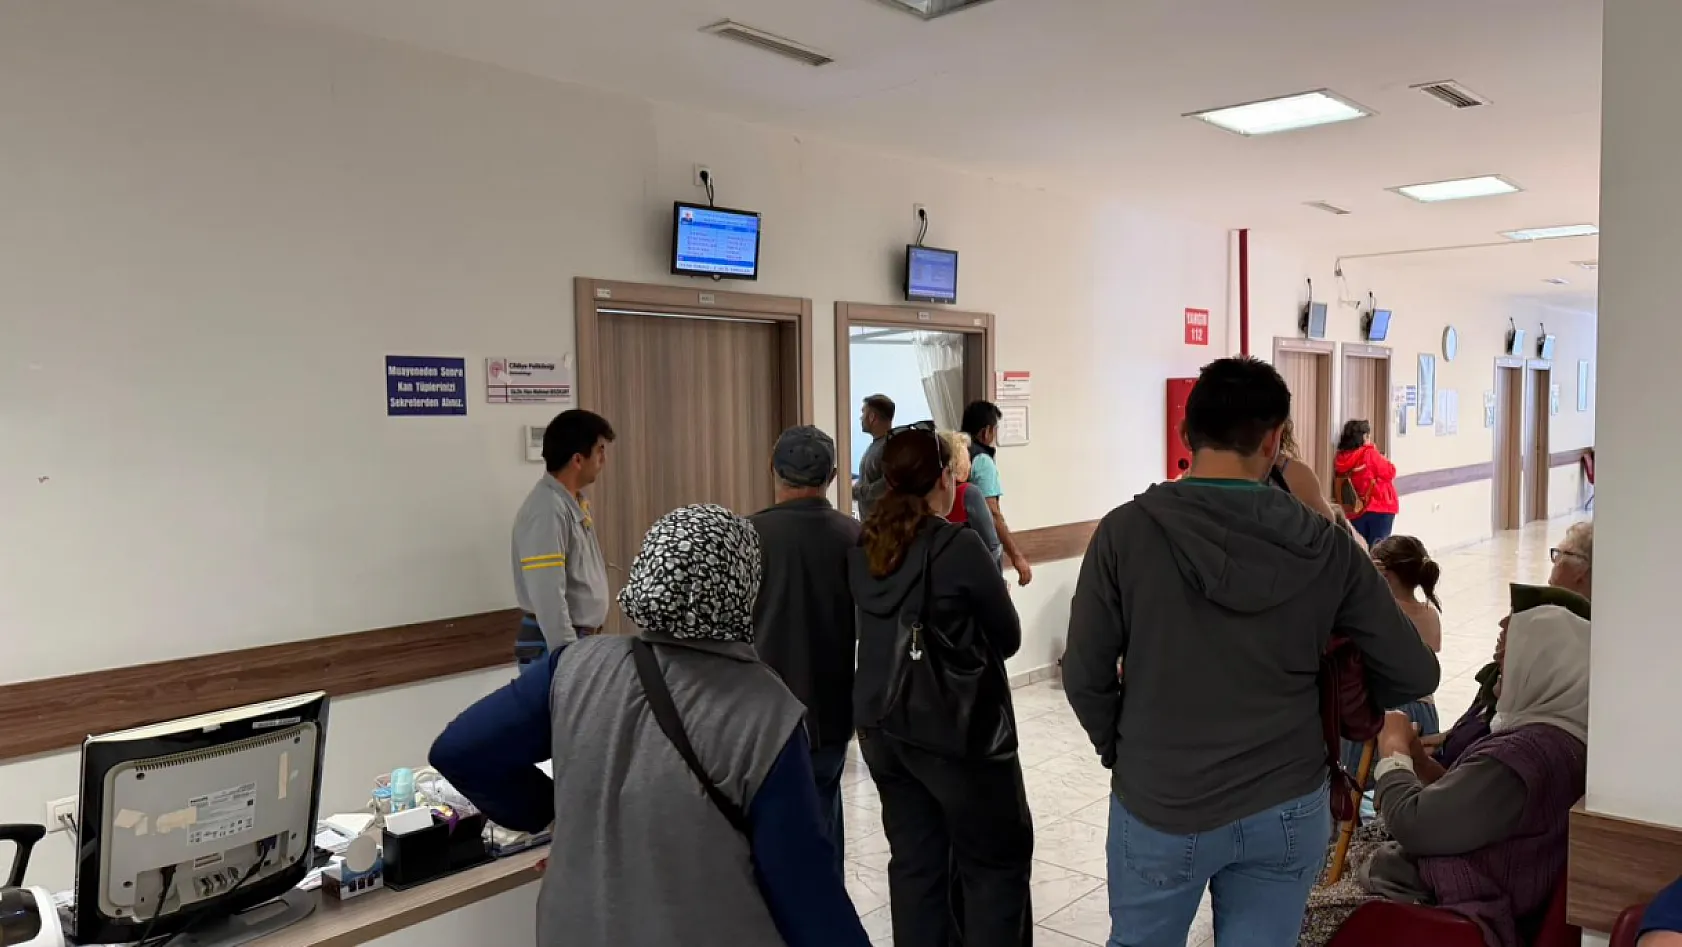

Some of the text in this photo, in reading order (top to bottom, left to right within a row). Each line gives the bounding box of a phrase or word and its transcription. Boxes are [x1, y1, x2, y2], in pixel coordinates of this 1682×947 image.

[1191, 327, 1203, 341] 112
[388, 366, 463, 377] Muayeneden Sonra
[397, 381, 413, 392] Kan
[390, 397, 439, 407] Sekreterden
